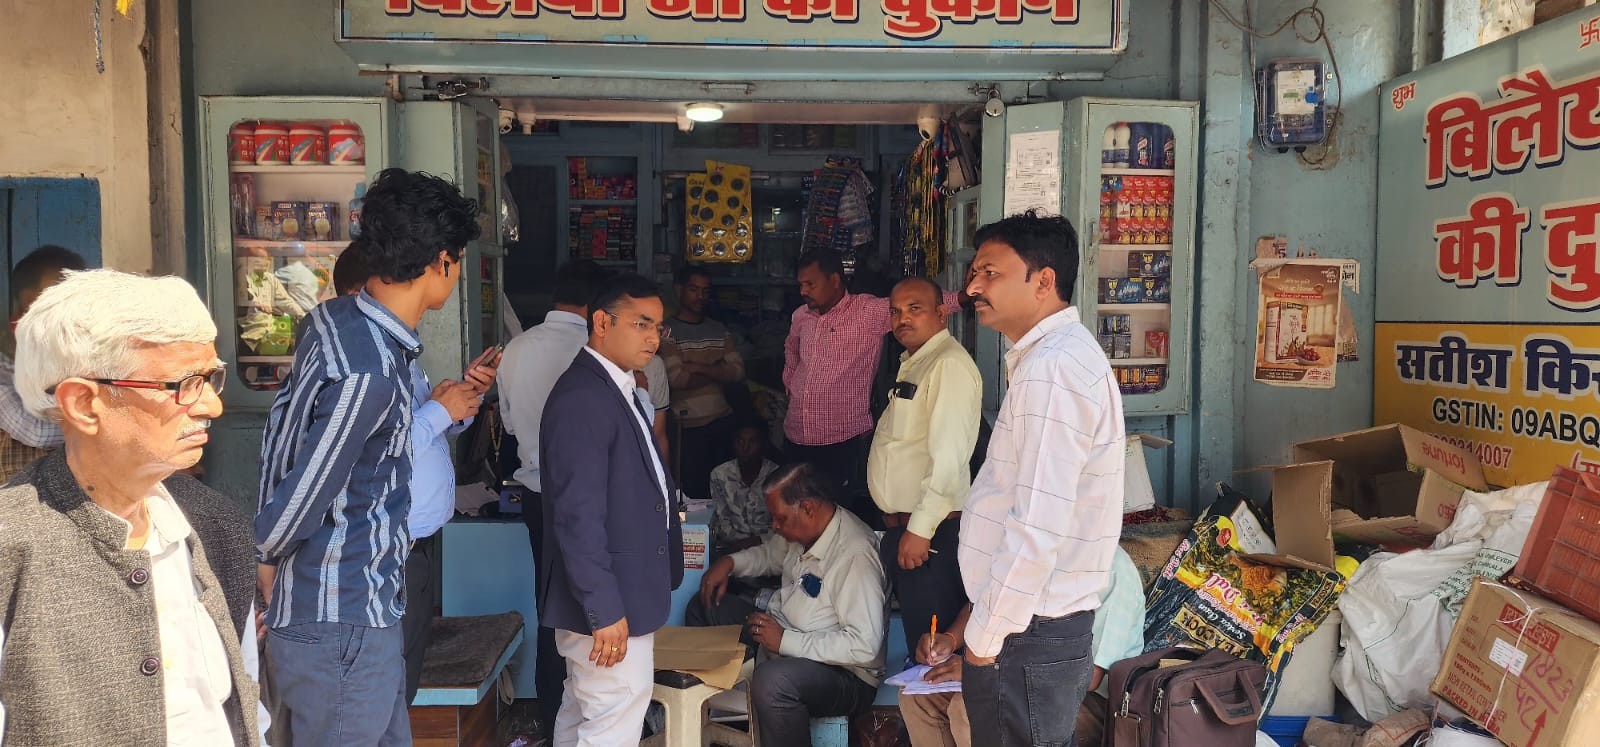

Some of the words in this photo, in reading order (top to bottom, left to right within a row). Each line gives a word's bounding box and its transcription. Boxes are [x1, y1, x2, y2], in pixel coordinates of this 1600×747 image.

[1392, 81, 1416, 111] शुभ
[1435, 194, 1530, 287] की
[1396, 335, 1513, 389] सतीश
[1433, 398, 1503, 431] GSTIN:
[1421, 441, 1466, 474] fortune
[1186, 613, 1244, 658] PEACOCK
